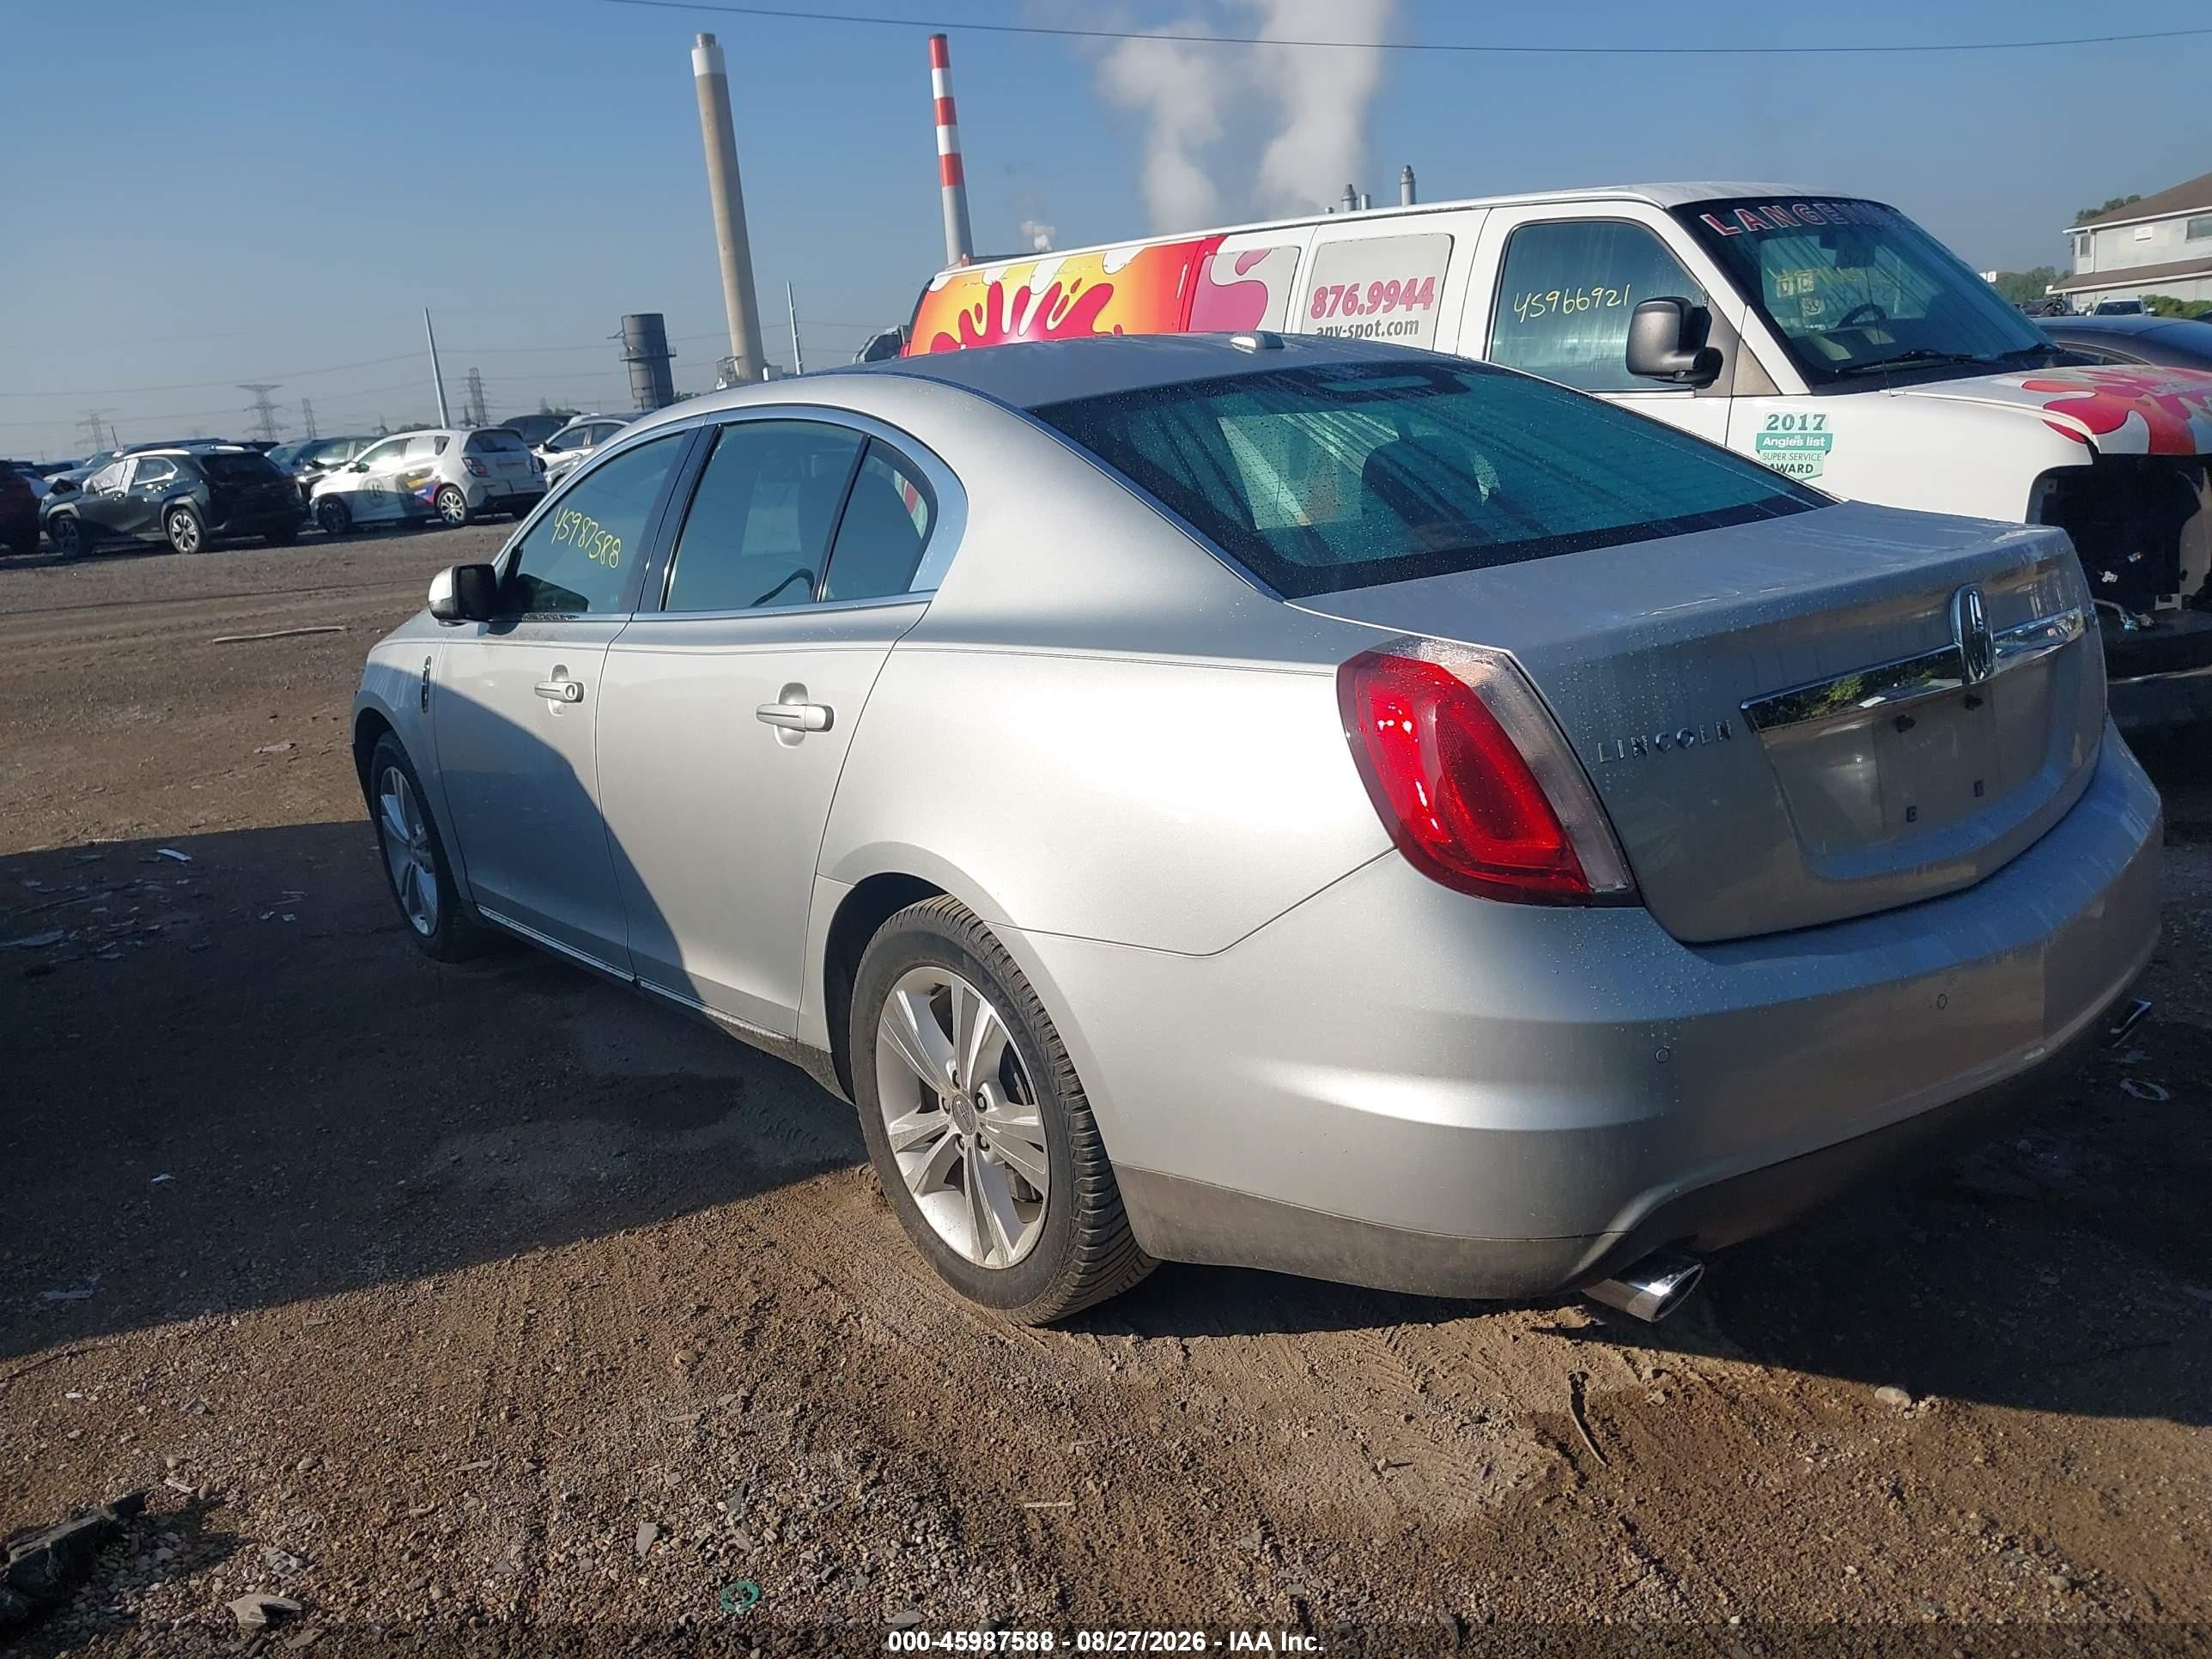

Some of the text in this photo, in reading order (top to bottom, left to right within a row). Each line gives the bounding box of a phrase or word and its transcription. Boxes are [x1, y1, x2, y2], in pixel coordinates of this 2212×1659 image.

[1310, 276, 1436, 319] 876.9944
[1765, 413, 1826, 431] 2017
[1806, 435, 1826, 447] list
[1763, 452, 1822, 462] SUPER SERVICE
[551, 506, 621, 568] 45987588
[1597, 720, 1732, 763] LINCOLN
